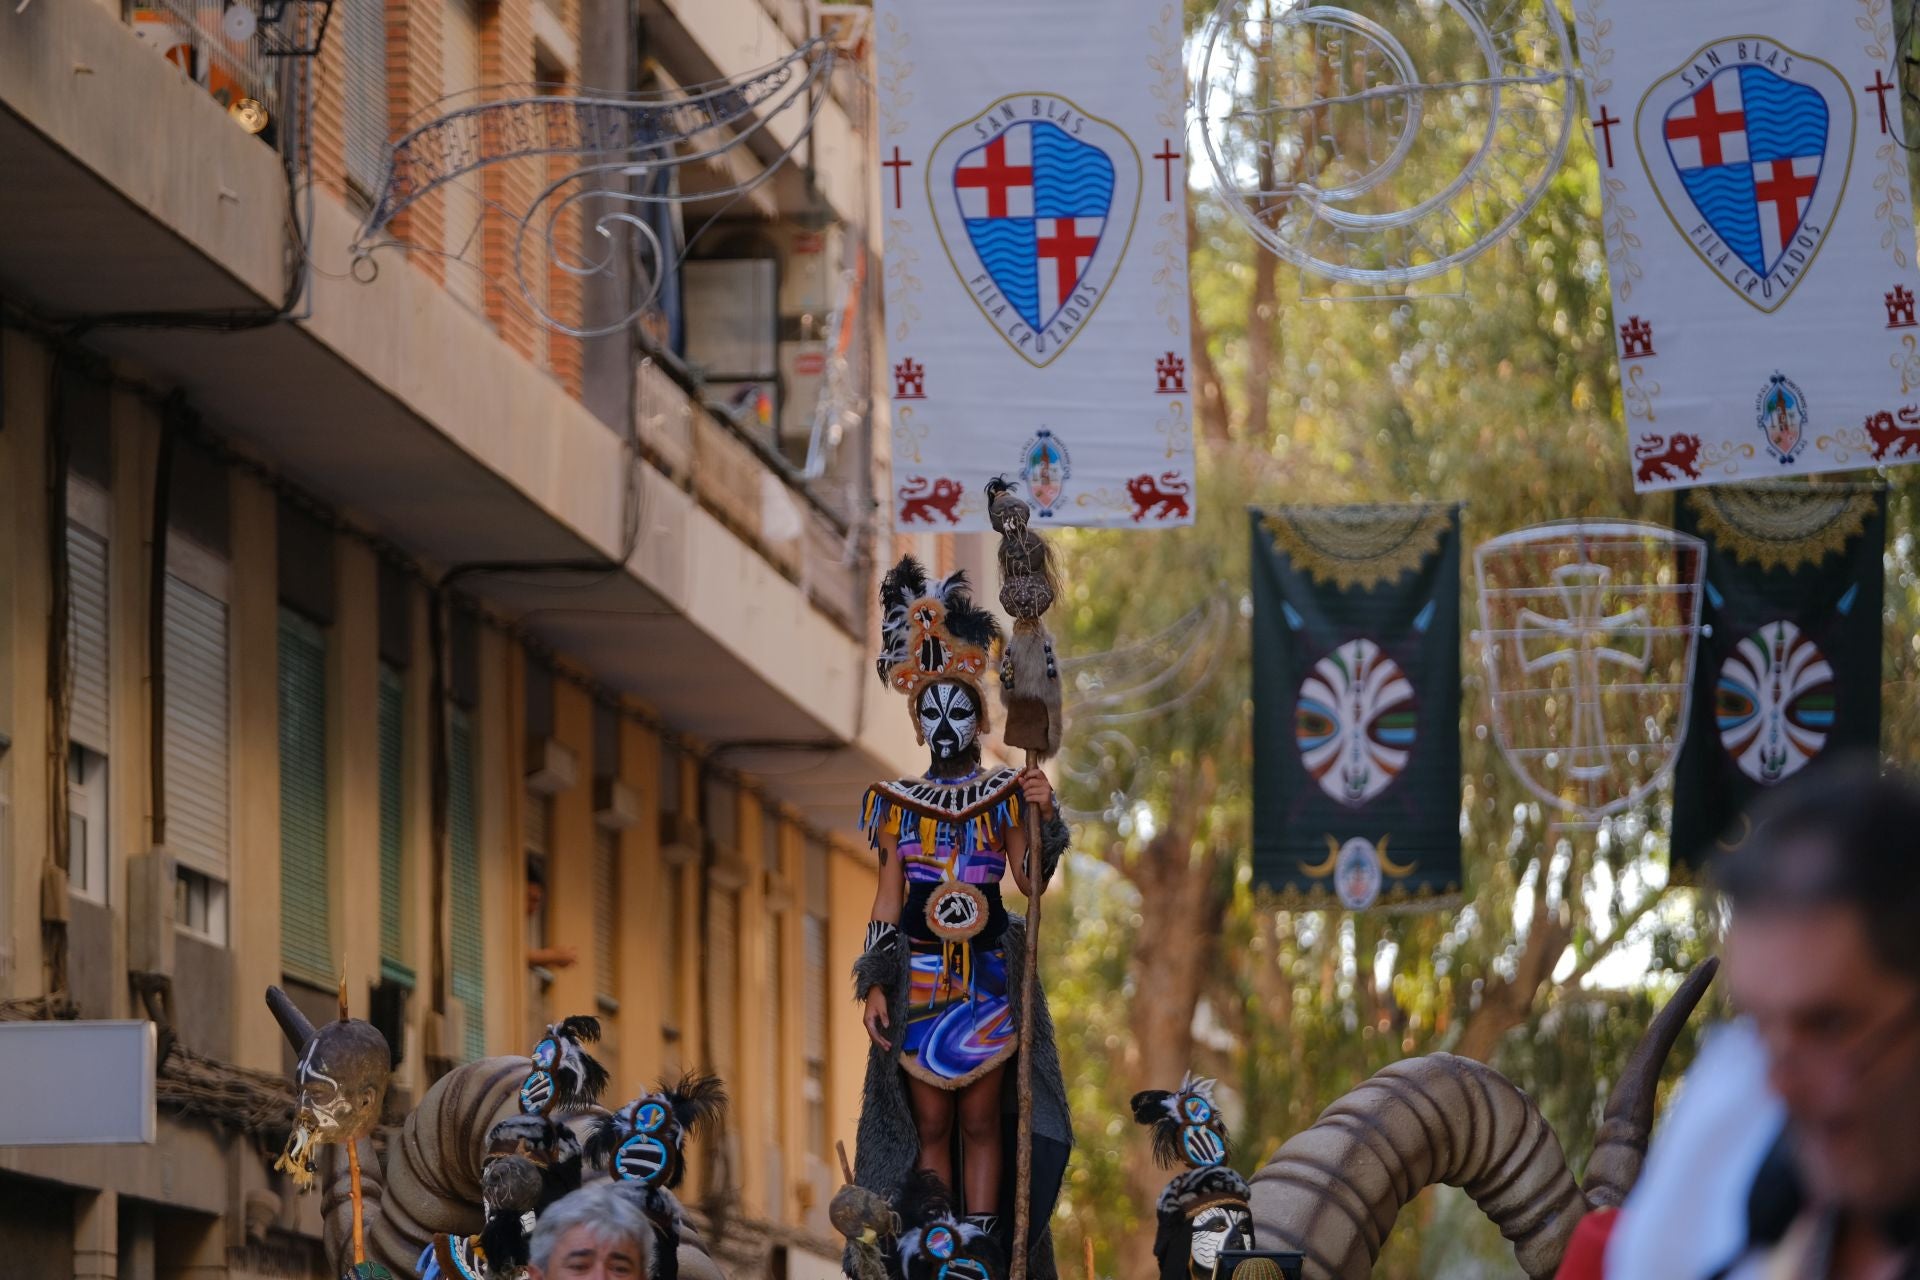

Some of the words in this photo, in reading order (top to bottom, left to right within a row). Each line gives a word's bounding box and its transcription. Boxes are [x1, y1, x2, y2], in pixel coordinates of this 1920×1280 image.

[1680, 49, 1722, 89] SAN
[1737, 41, 1793, 75] BLAS
[974, 103, 1016, 140] SAN
[1031, 98, 1084, 135] BLAS
[1689, 222, 1730, 268] FILA
[1734, 222, 1821, 298] CRUZADOS
[970, 273, 1008, 319] FILA
[1008, 282, 1099, 353] CRUZADOS
